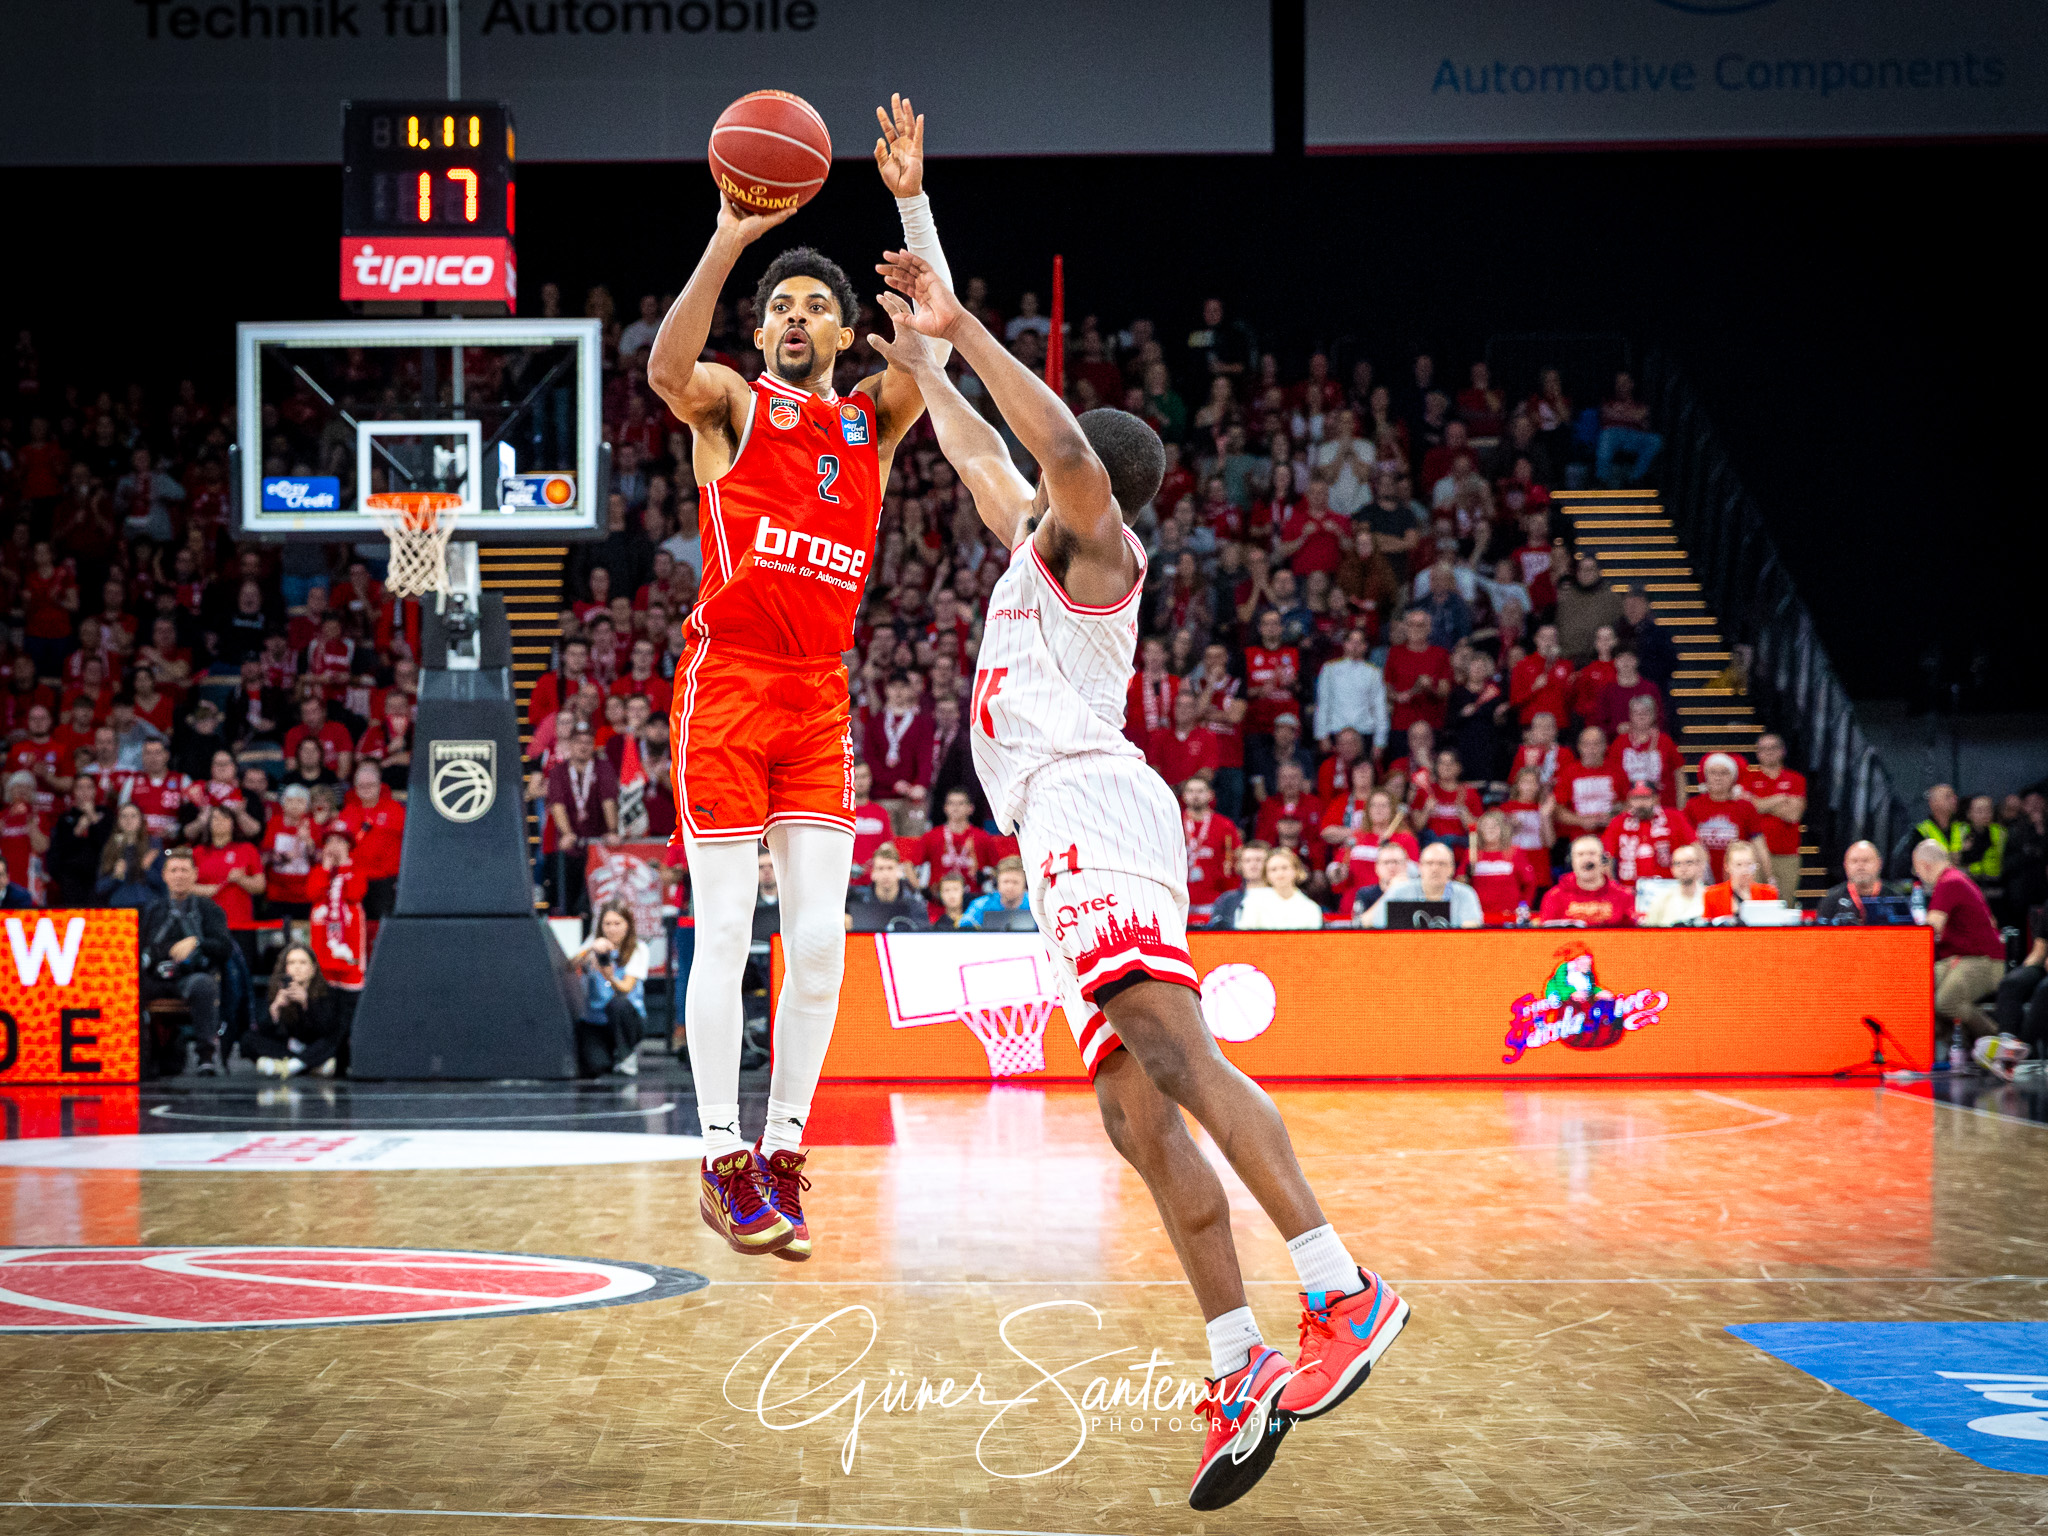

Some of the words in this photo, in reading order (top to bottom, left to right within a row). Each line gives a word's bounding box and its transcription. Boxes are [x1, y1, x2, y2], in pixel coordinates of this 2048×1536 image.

[135, 0, 358, 38] Technik
[482, 0, 817, 35] Automobile
[1431, 58, 1696, 95] Automotive
[1714, 52, 2005, 96] Components
[418, 168, 478, 222] 17
[720, 172, 799, 209] SPALDING
[353, 244, 494, 293] tipico
[846, 431, 866, 442] BBL
[817, 454, 840, 504] 2
[753, 555, 797, 574] Technik
[754, 516, 866, 578] brose
